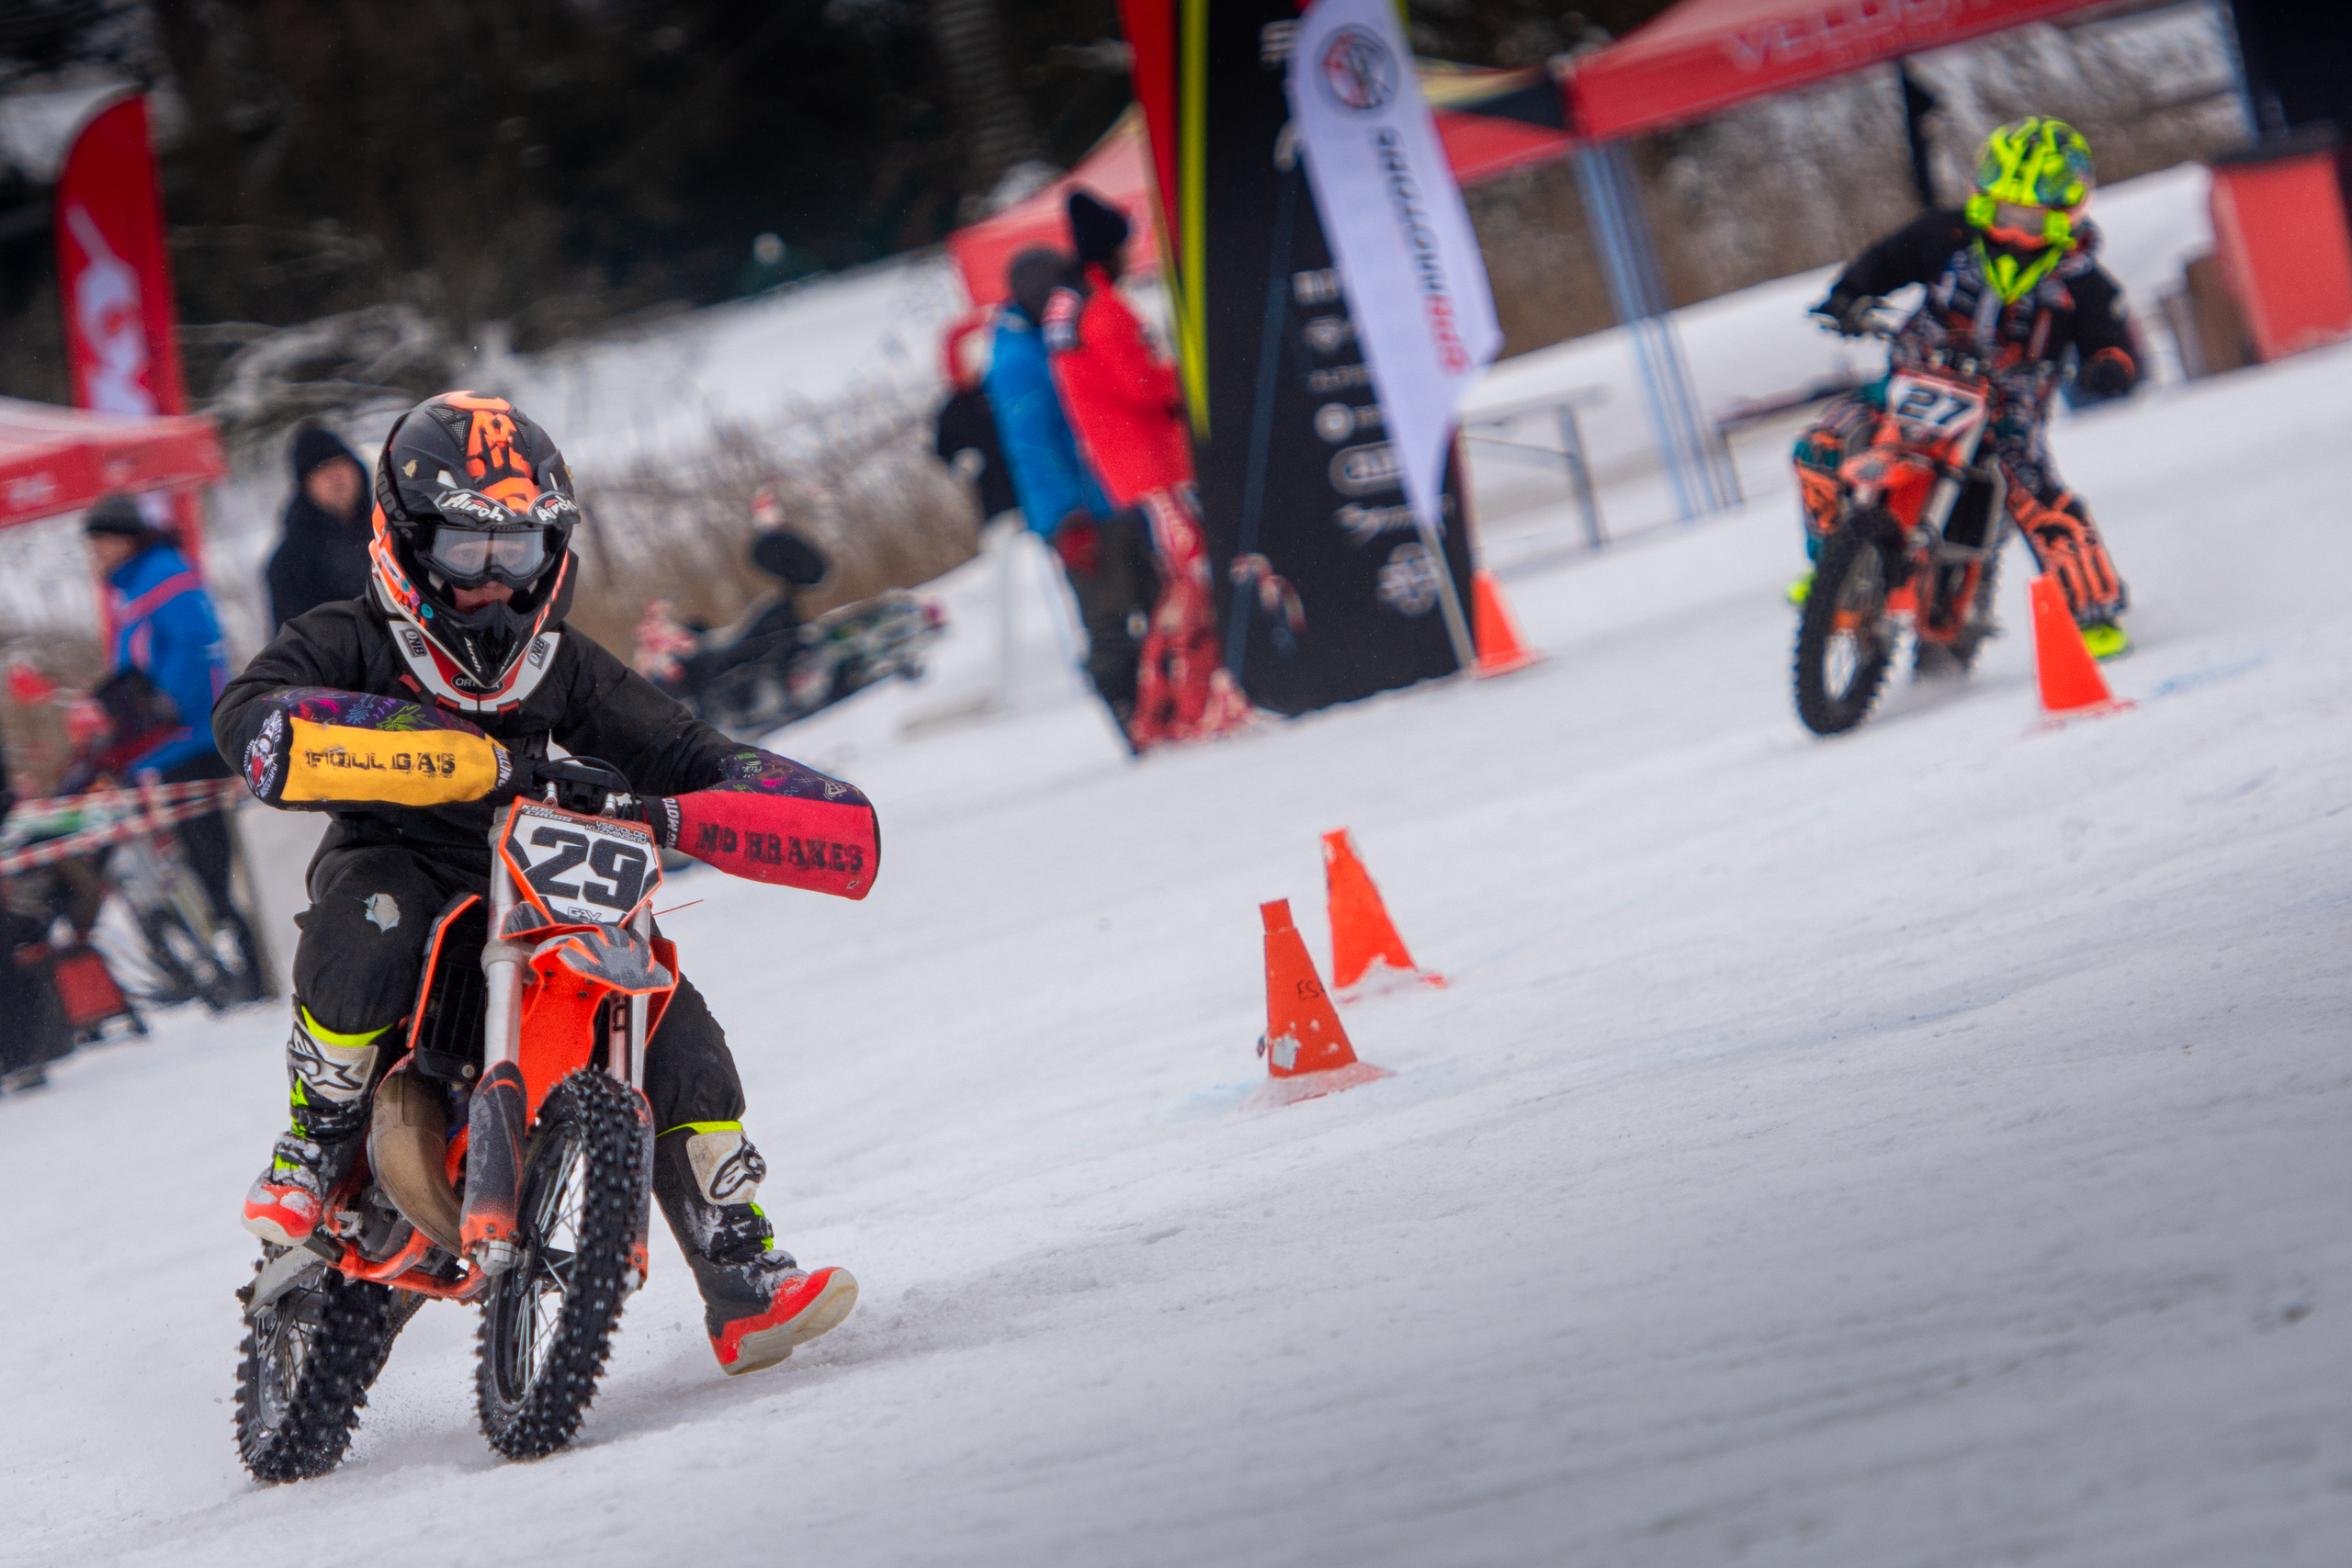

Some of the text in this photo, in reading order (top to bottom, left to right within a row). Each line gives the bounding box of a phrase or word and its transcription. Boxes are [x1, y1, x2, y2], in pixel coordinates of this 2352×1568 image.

[1896, 388, 1973, 425] 27
[442, 492, 505, 522] Airoh
[464, 637, 482, 673] Airoh
[305, 749, 456, 778] FULL GAS
[525, 809, 573, 822] CROSS
[695, 822, 865, 875] NO BRAKES
[522, 825, 648, 913] 29
